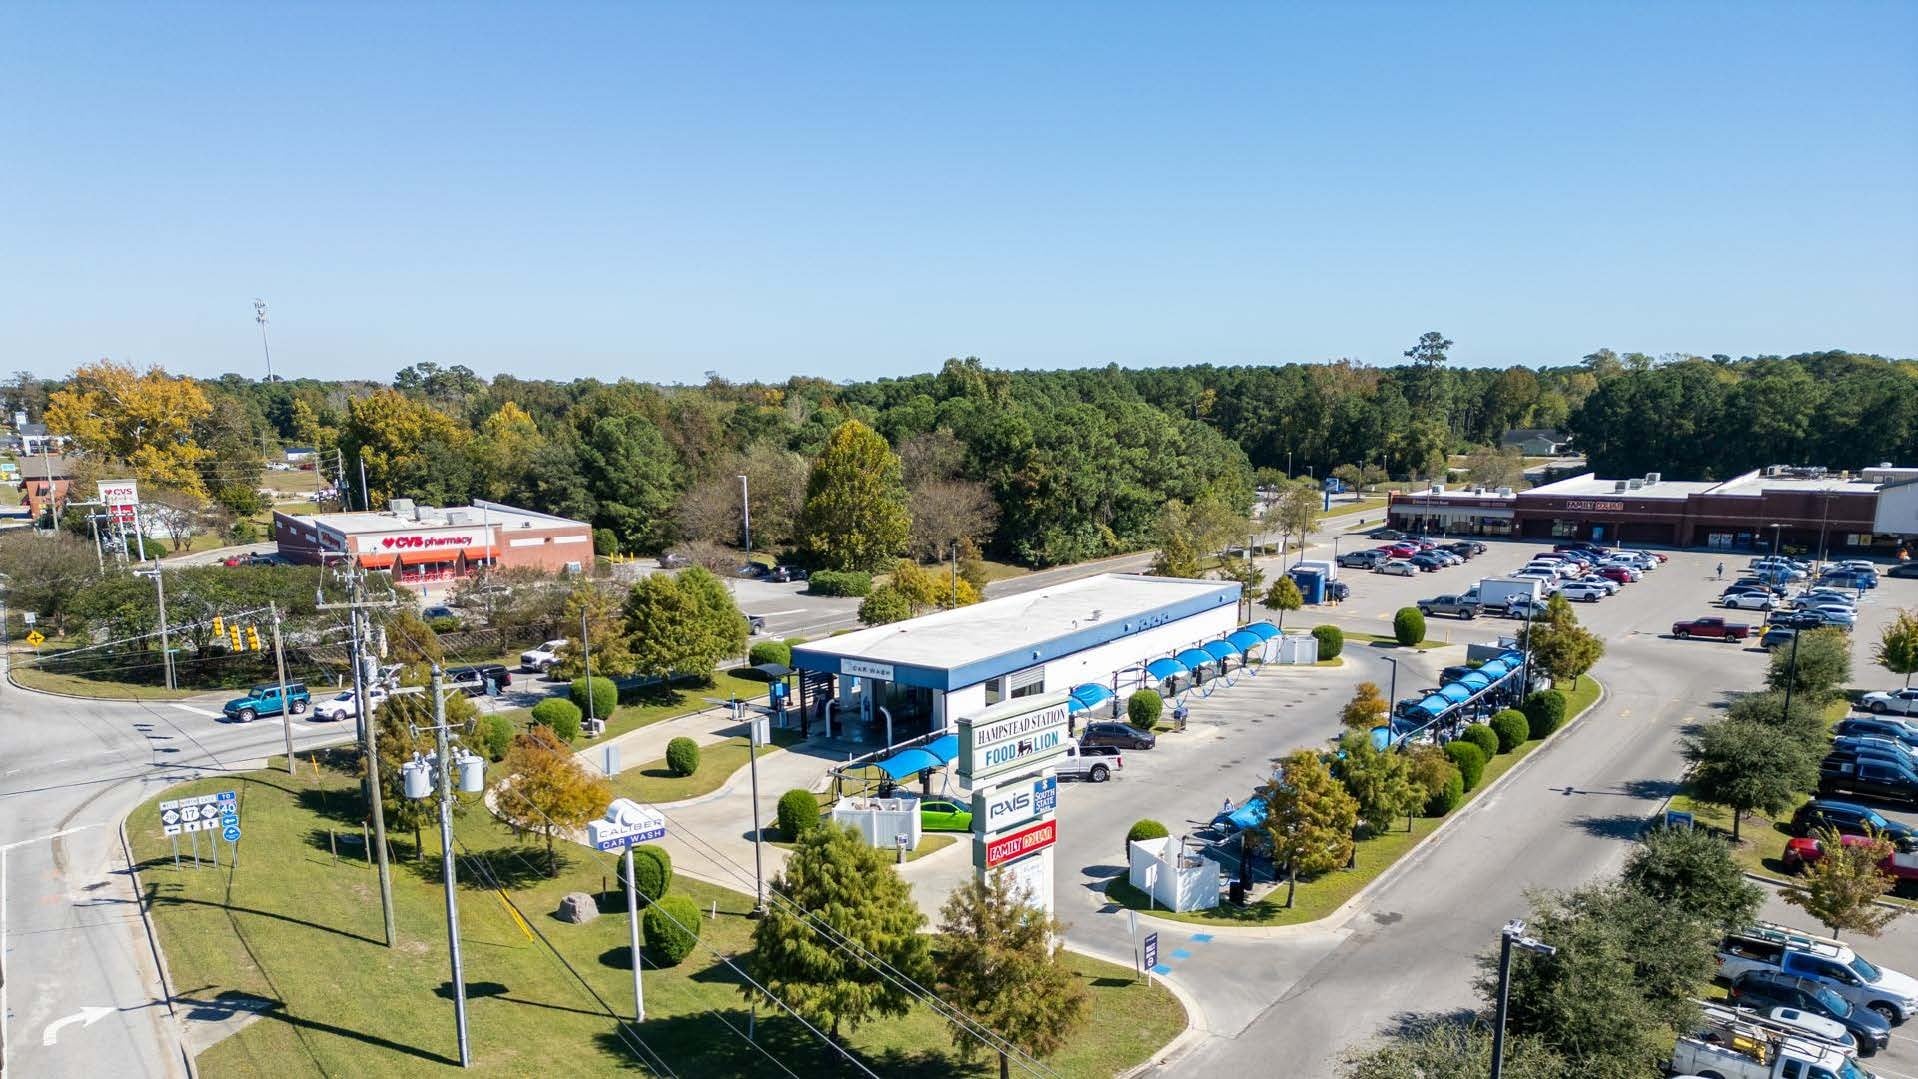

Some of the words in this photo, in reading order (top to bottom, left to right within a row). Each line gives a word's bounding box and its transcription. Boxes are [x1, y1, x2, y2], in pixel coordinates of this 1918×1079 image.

[395, 536, 423, 549] CVS
[425, 535, 472, 548] pharmacy
[978, 718, 1030, 745] HAMPSTEAD
[1031, 708, 1065, 728] STATION
[985, 744, 1016, 766] FOOD
[1034, 730, 1059, 752] LION
[1035, 788, 1055, 801] SOUTH
[221, 804, 236, 814] 40
[1036, 797, 1054, 811] STATE
[185, 809, 195, 819] 17
[600, 818, 663, 838] CALIBER
[602, 839, 625, 849] CAR
[630, 830, 661, 842] WASH
[990, 837, 1022, 861] FAMILY
